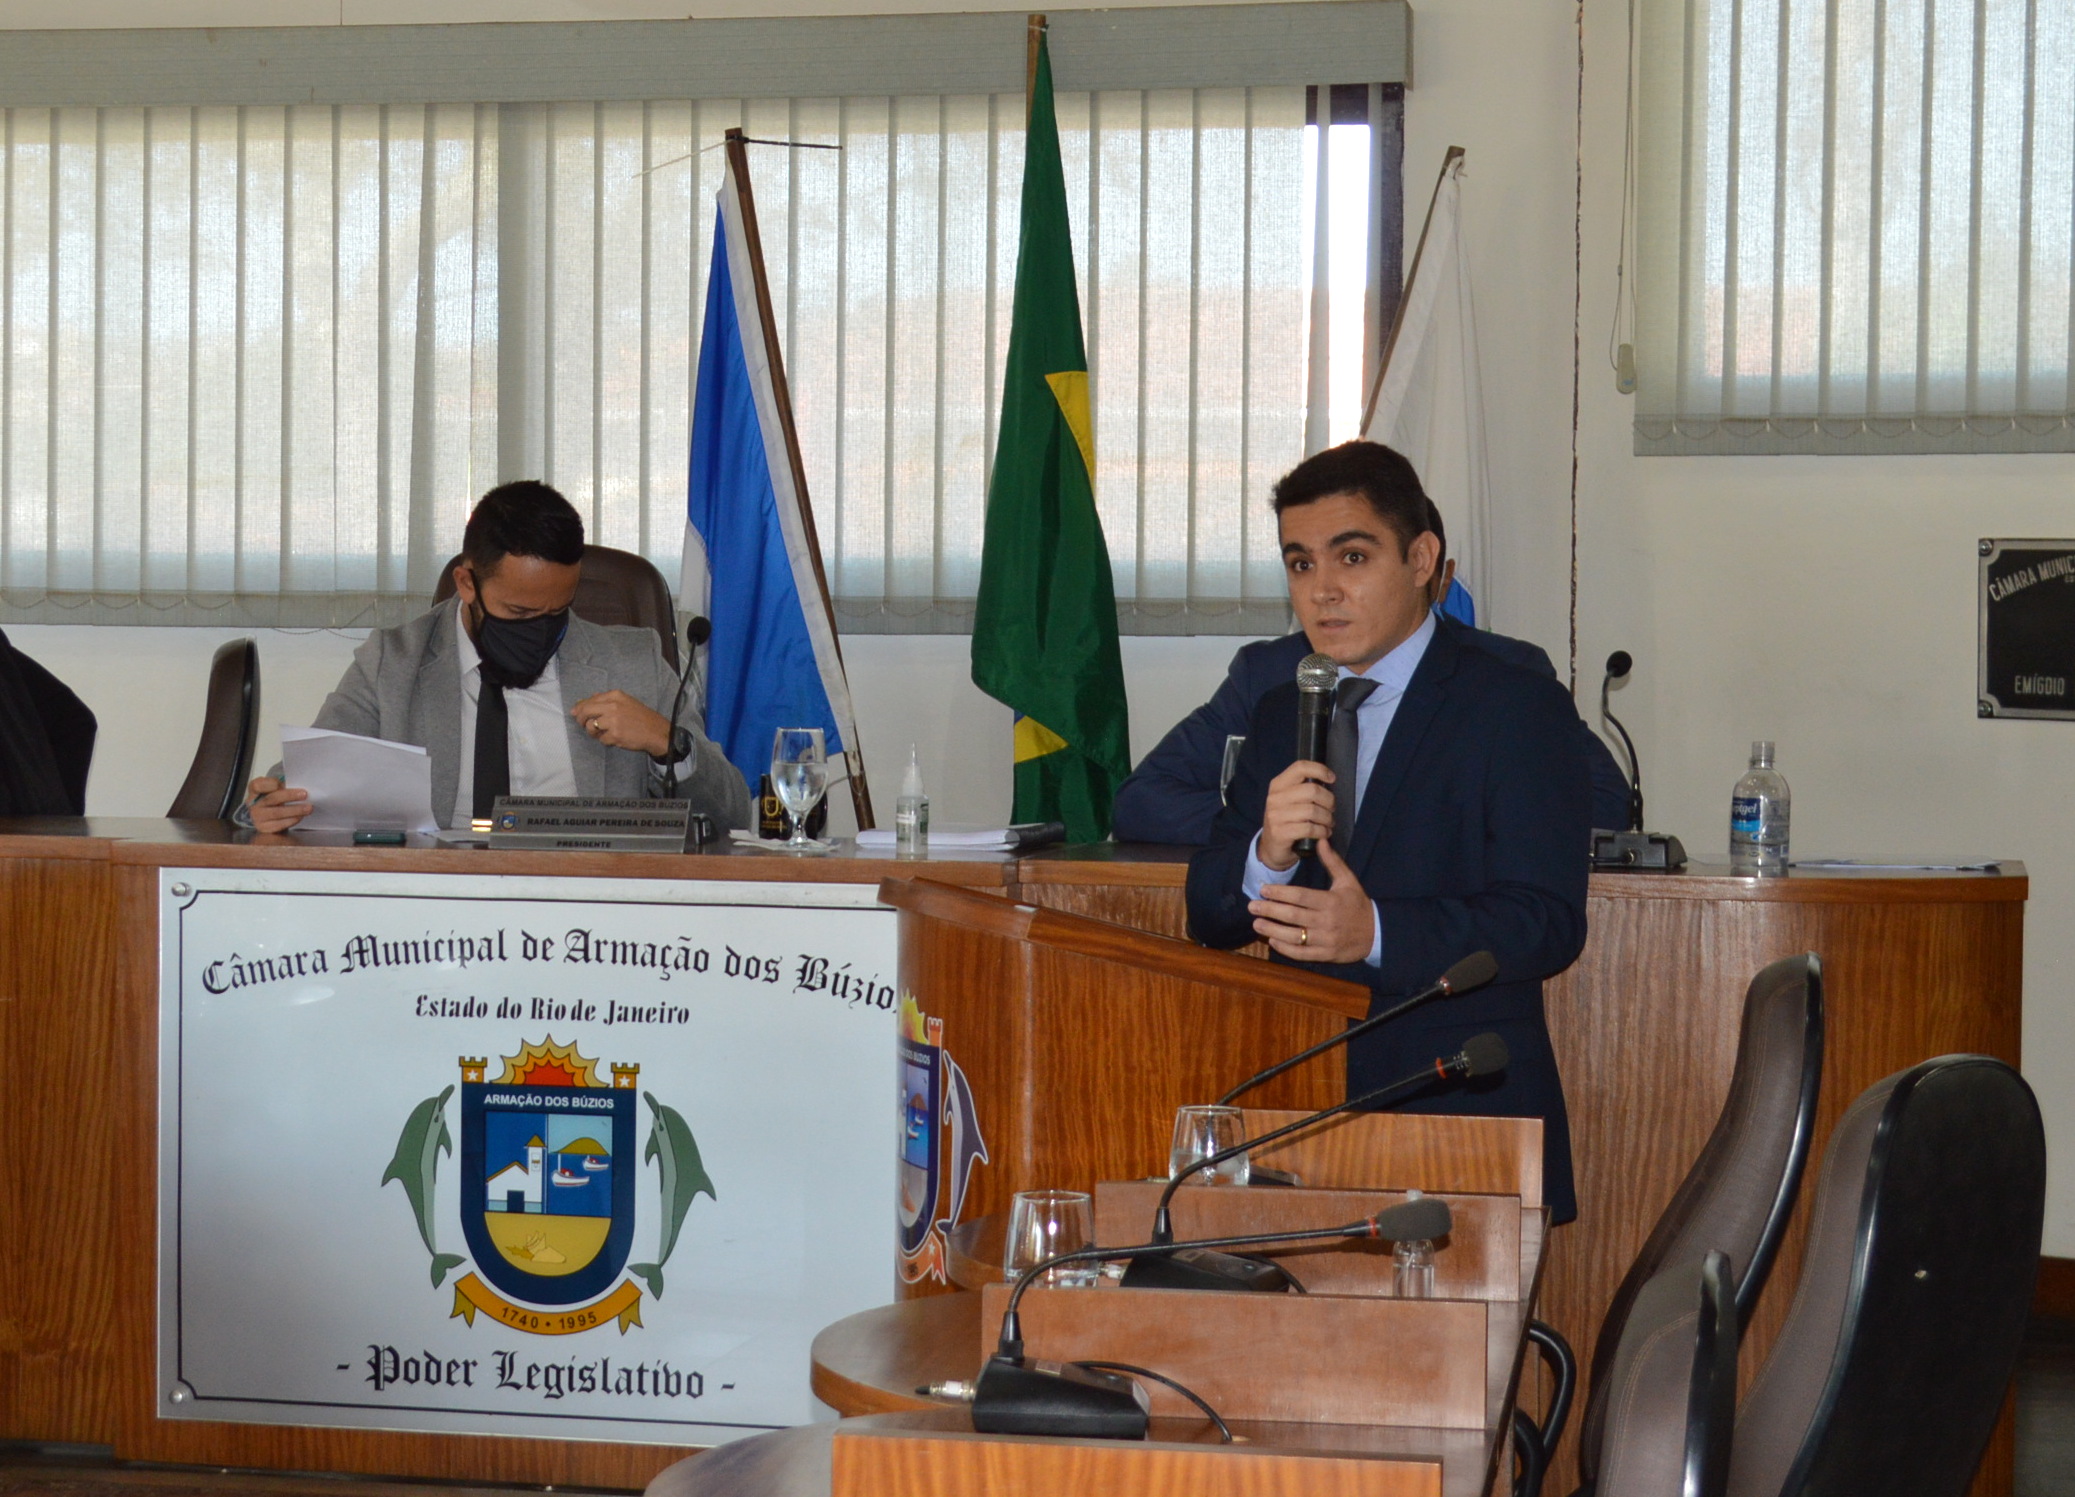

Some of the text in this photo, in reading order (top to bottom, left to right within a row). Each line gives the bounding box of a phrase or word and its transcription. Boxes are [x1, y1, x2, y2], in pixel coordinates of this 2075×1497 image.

[2037, 555, 2075, 581] MUNIC
[2014, 673, 2065, 696] EMÍGDIO
[537, 799, 579, 807] MUNICIPAL
[527, 818, 685, 828] RAFAEL AGUIAR PEREIRA DE SOUZA
[202, 929, 897, 1014] Câmara Municipal de Armação dos Búzio
[416, 994, 690, 1026] Estado do Rio de Janeiro
[484, 1093, 615, 1109] ARMAÇÃO DOS BÚZIOS
[502, 1307, 597, 1329] 1740 1995
[365, 1344, 478, 1391] Poder
[492, 1350, 704, 1400] Legislativo
